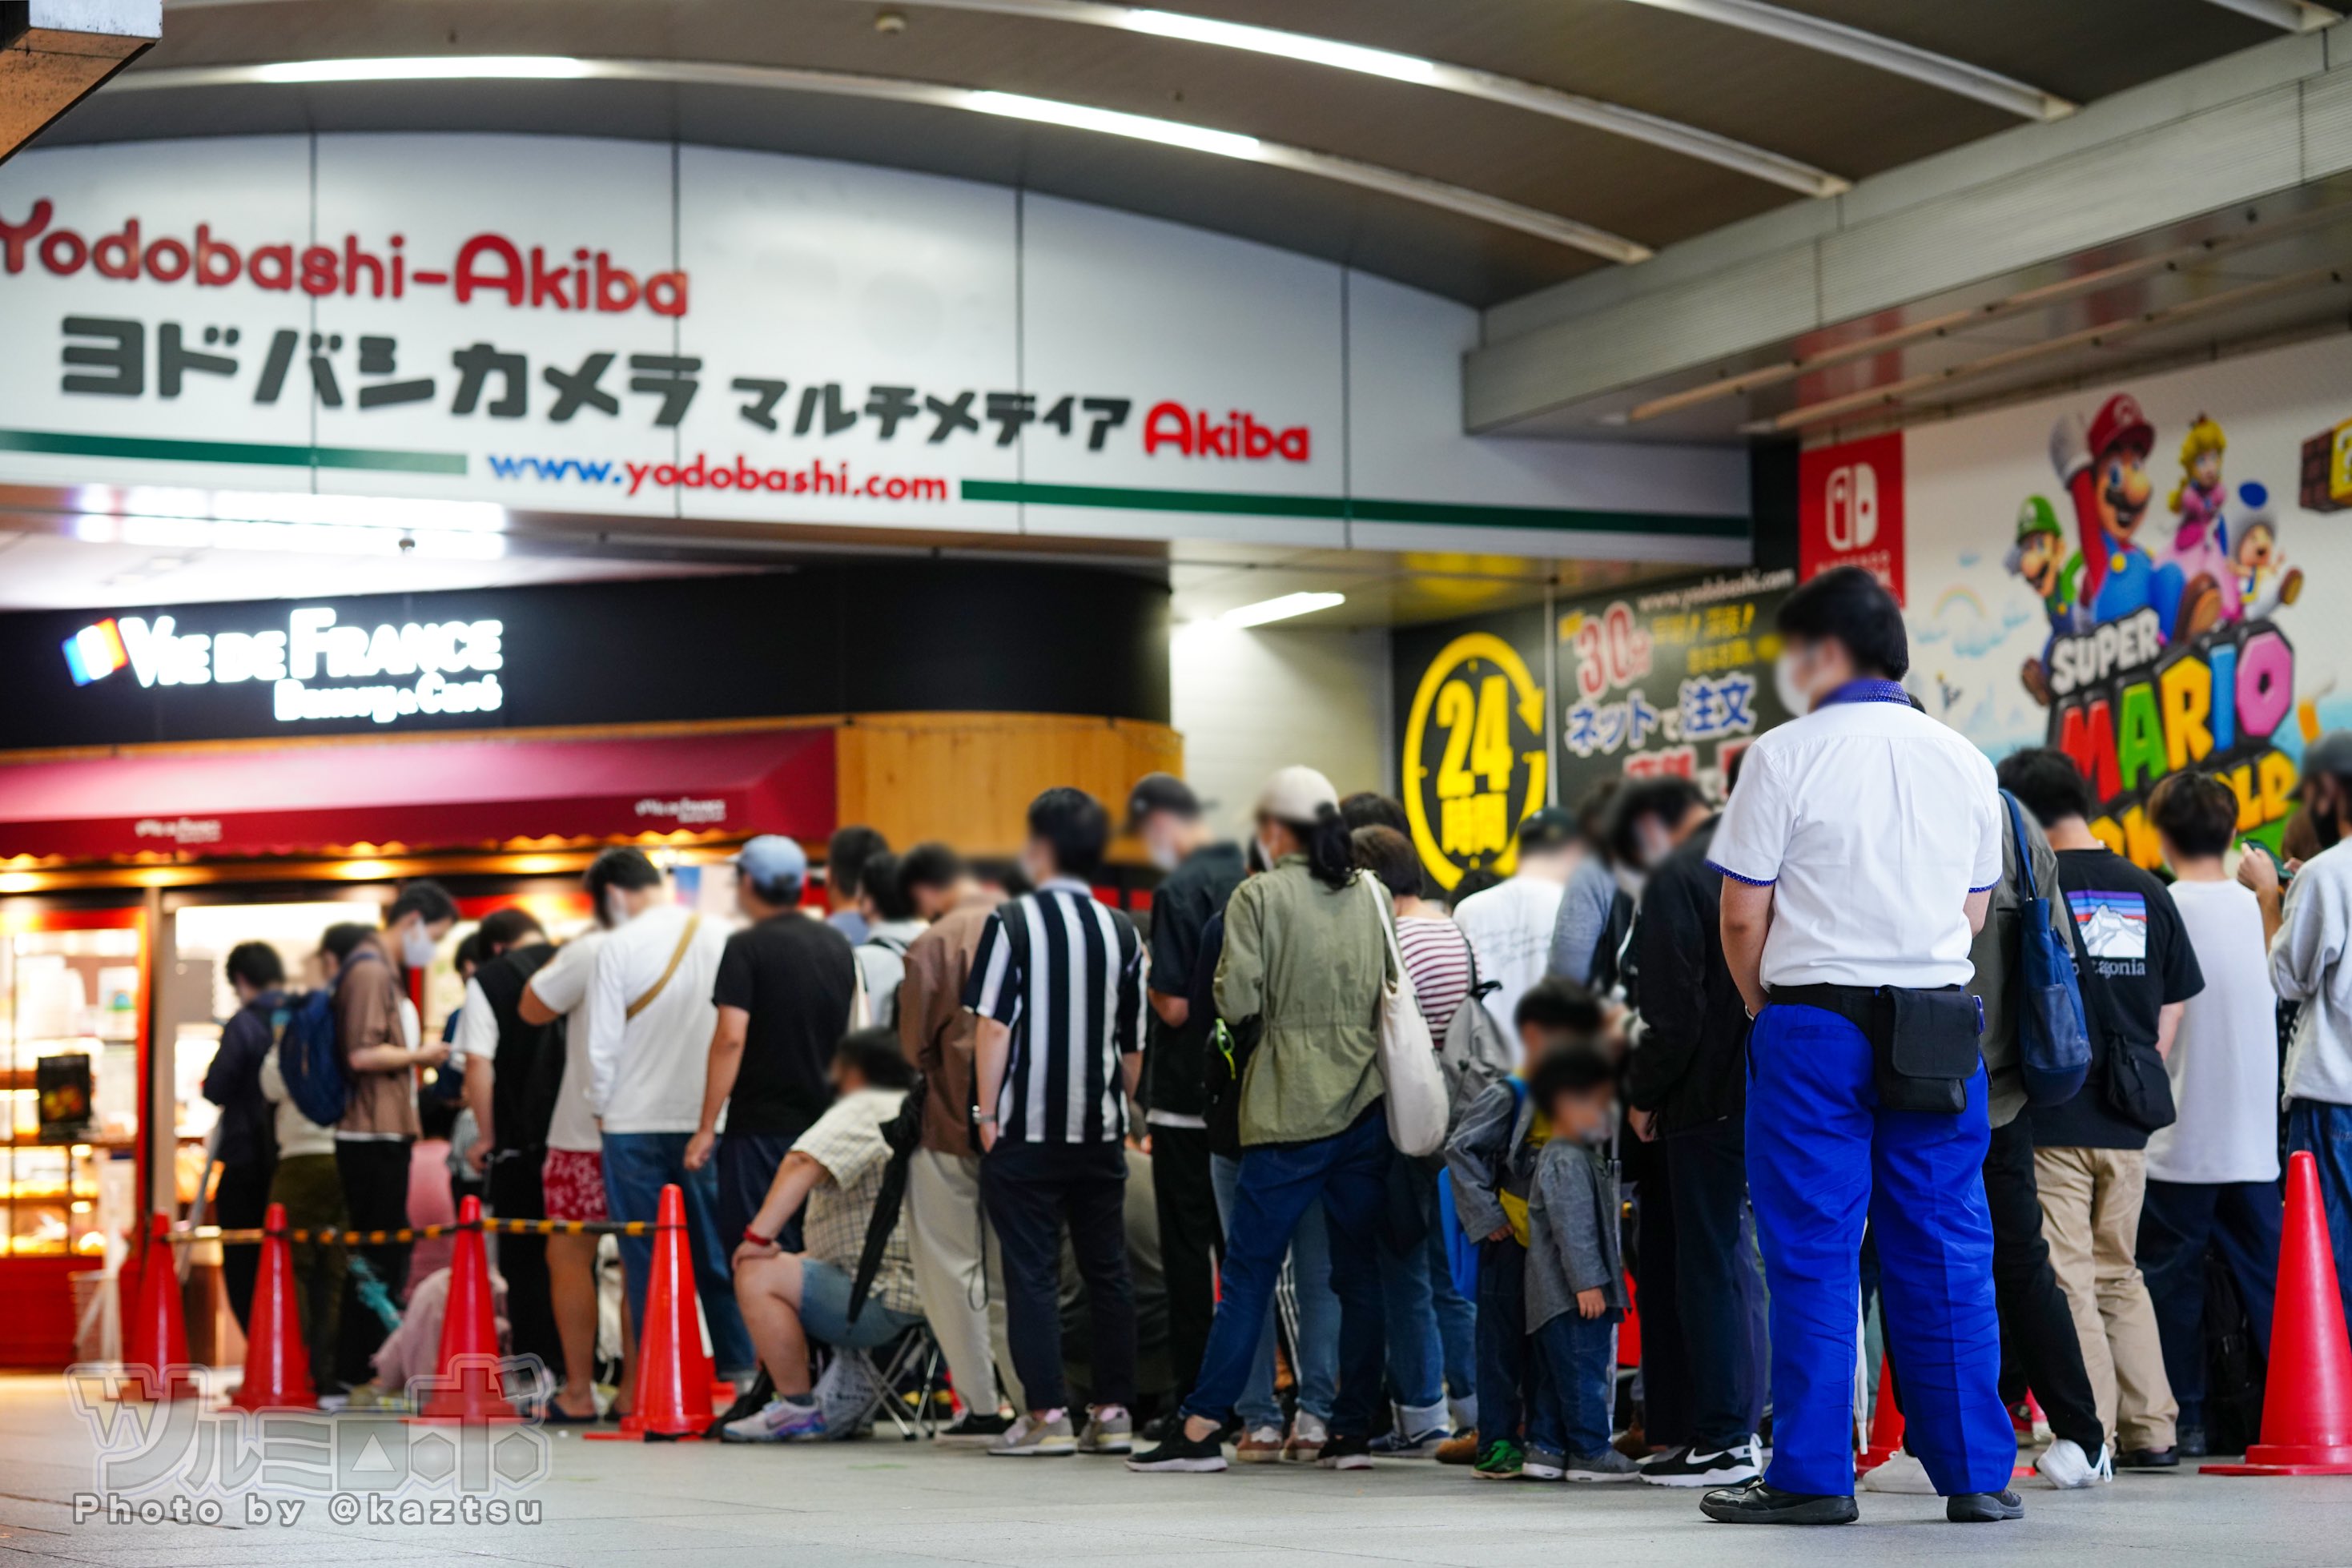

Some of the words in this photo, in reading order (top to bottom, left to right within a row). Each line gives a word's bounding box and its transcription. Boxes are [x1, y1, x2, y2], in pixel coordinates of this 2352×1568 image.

[0, 198, 688, 318] Yodobashi-Akiba
[61, 316, 703, 428] ヨドバシカメラ
[730, 376, 1132, 451] マルチメディア
[1144, 400, 1310, 462] Akiba
[489, 453, 948, 497] www.yodobashi.com
[2050, 609, 2160, 695] SUPER
[1436, 674, 1514, 799] 24
[1566, 674, 1756, 757] ネットで注文
[2060, 631, 2293, 803] MARIO
